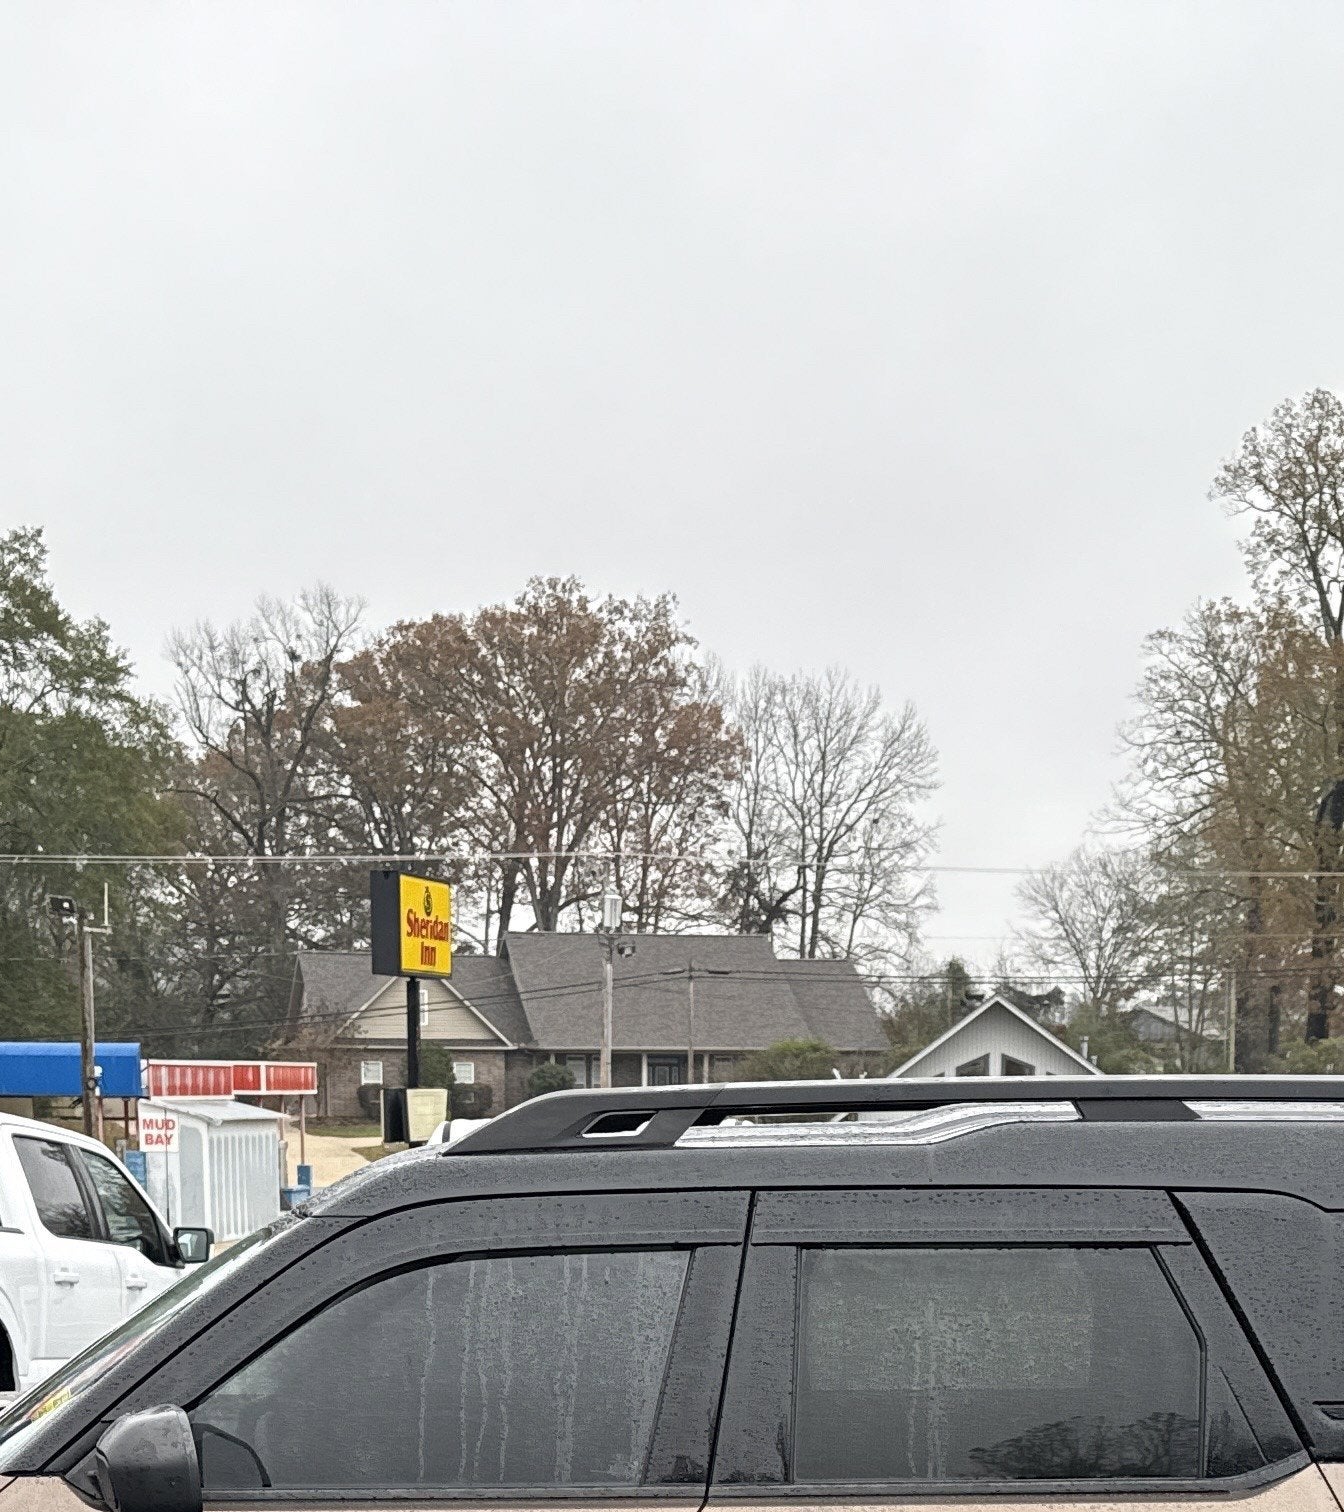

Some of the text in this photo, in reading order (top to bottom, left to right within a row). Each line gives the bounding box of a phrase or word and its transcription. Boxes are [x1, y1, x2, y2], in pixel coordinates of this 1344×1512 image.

[406, 908, 449, 942] Sheridan
[420, 941, 436, 967] Inn
[142, 1118, 176, 1130] MUD
[145, 1134, 174, 1145] BAY
